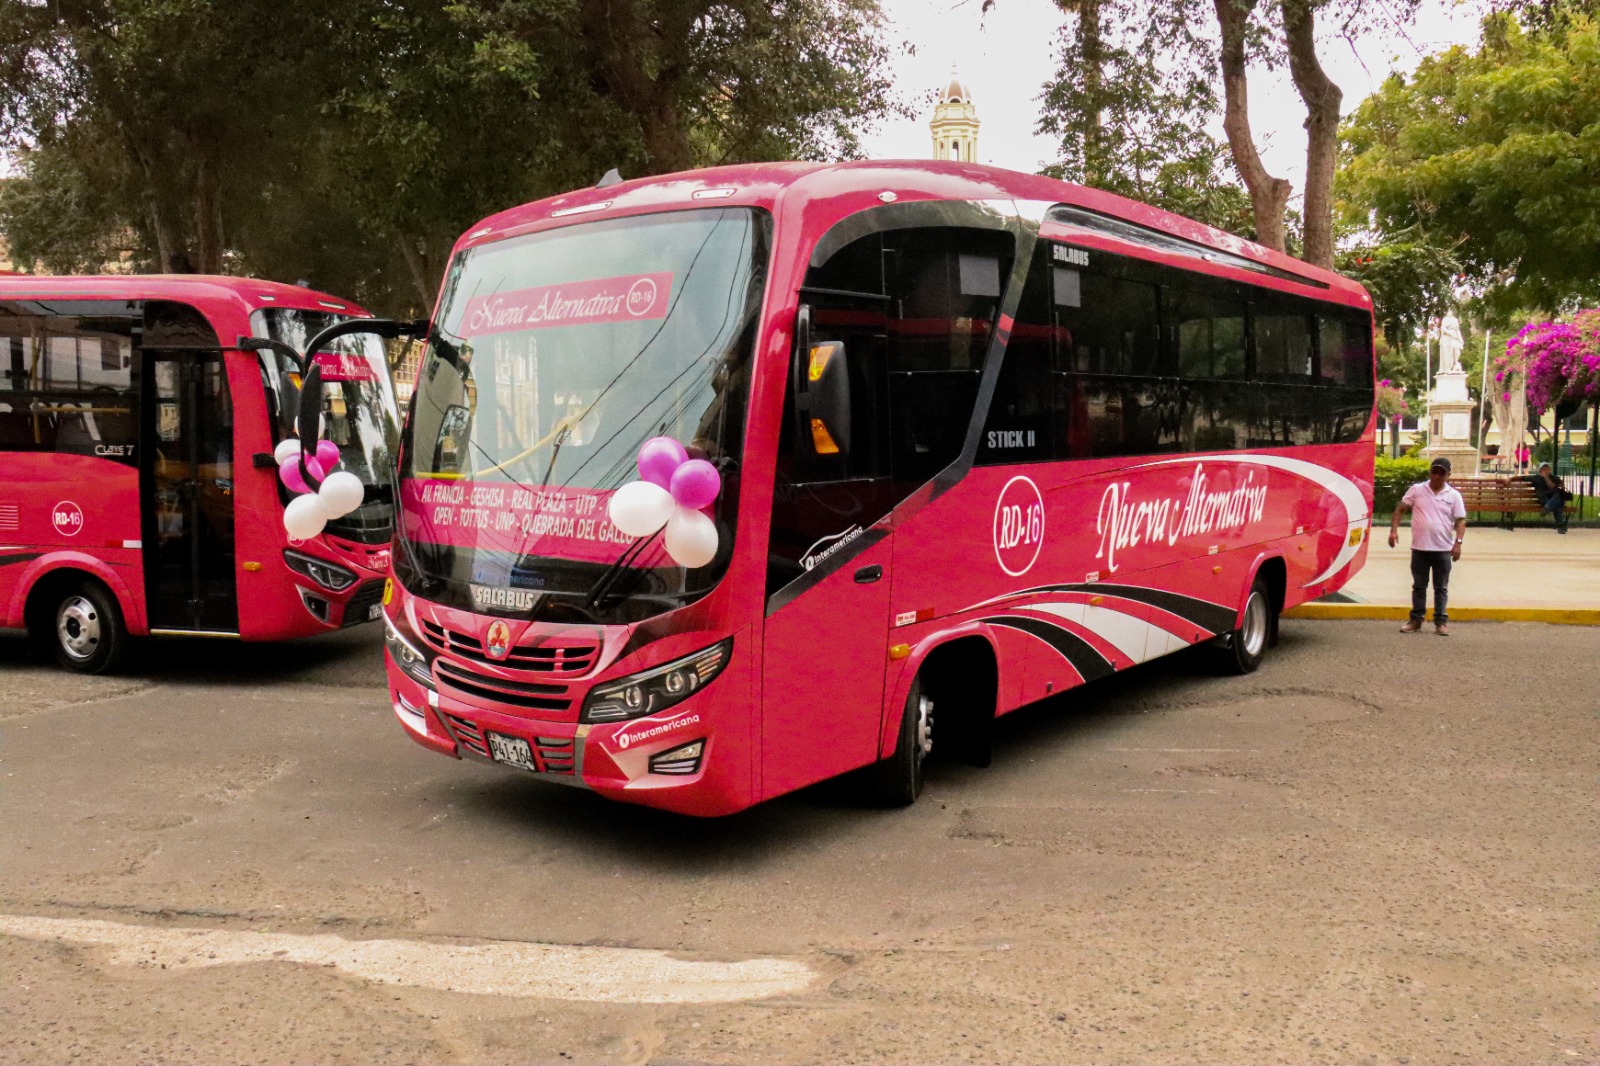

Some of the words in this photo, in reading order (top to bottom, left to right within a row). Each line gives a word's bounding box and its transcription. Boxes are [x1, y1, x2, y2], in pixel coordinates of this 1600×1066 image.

[1053, 244, 1089, 267] SALABUS
[630, 290, 653, 304] RD-16
[470, 299, 527, 330] Nueva
[526, 290, 625, 323] Alternativa
[125, 444, 135, 456] 7
[988, 431, 1025, 448] STICK
[433, 485, 464, 504] FRANCIA
[511, 489, 533, 511] REAL
[535, 491, 566, 514] PLAZA
[575, 494, 598, 516] UTP
[55, 511, 80, 525] RD-16
[433, 506, 454, 525] OPEN
[459, 508, 490, 529] TOTTUS
[495, 511, 516, 531] UNP
[521, 513, 574, 538] QUEBRADA
[576, 518, 595, 540] DEL
[998, 502, 1041, 549] RD-16
[1095, 481, 1170, 572] Nueva
[1168, 462, 1268, 547] Alternativa
[476, 586, 534, 609] SALABUS
